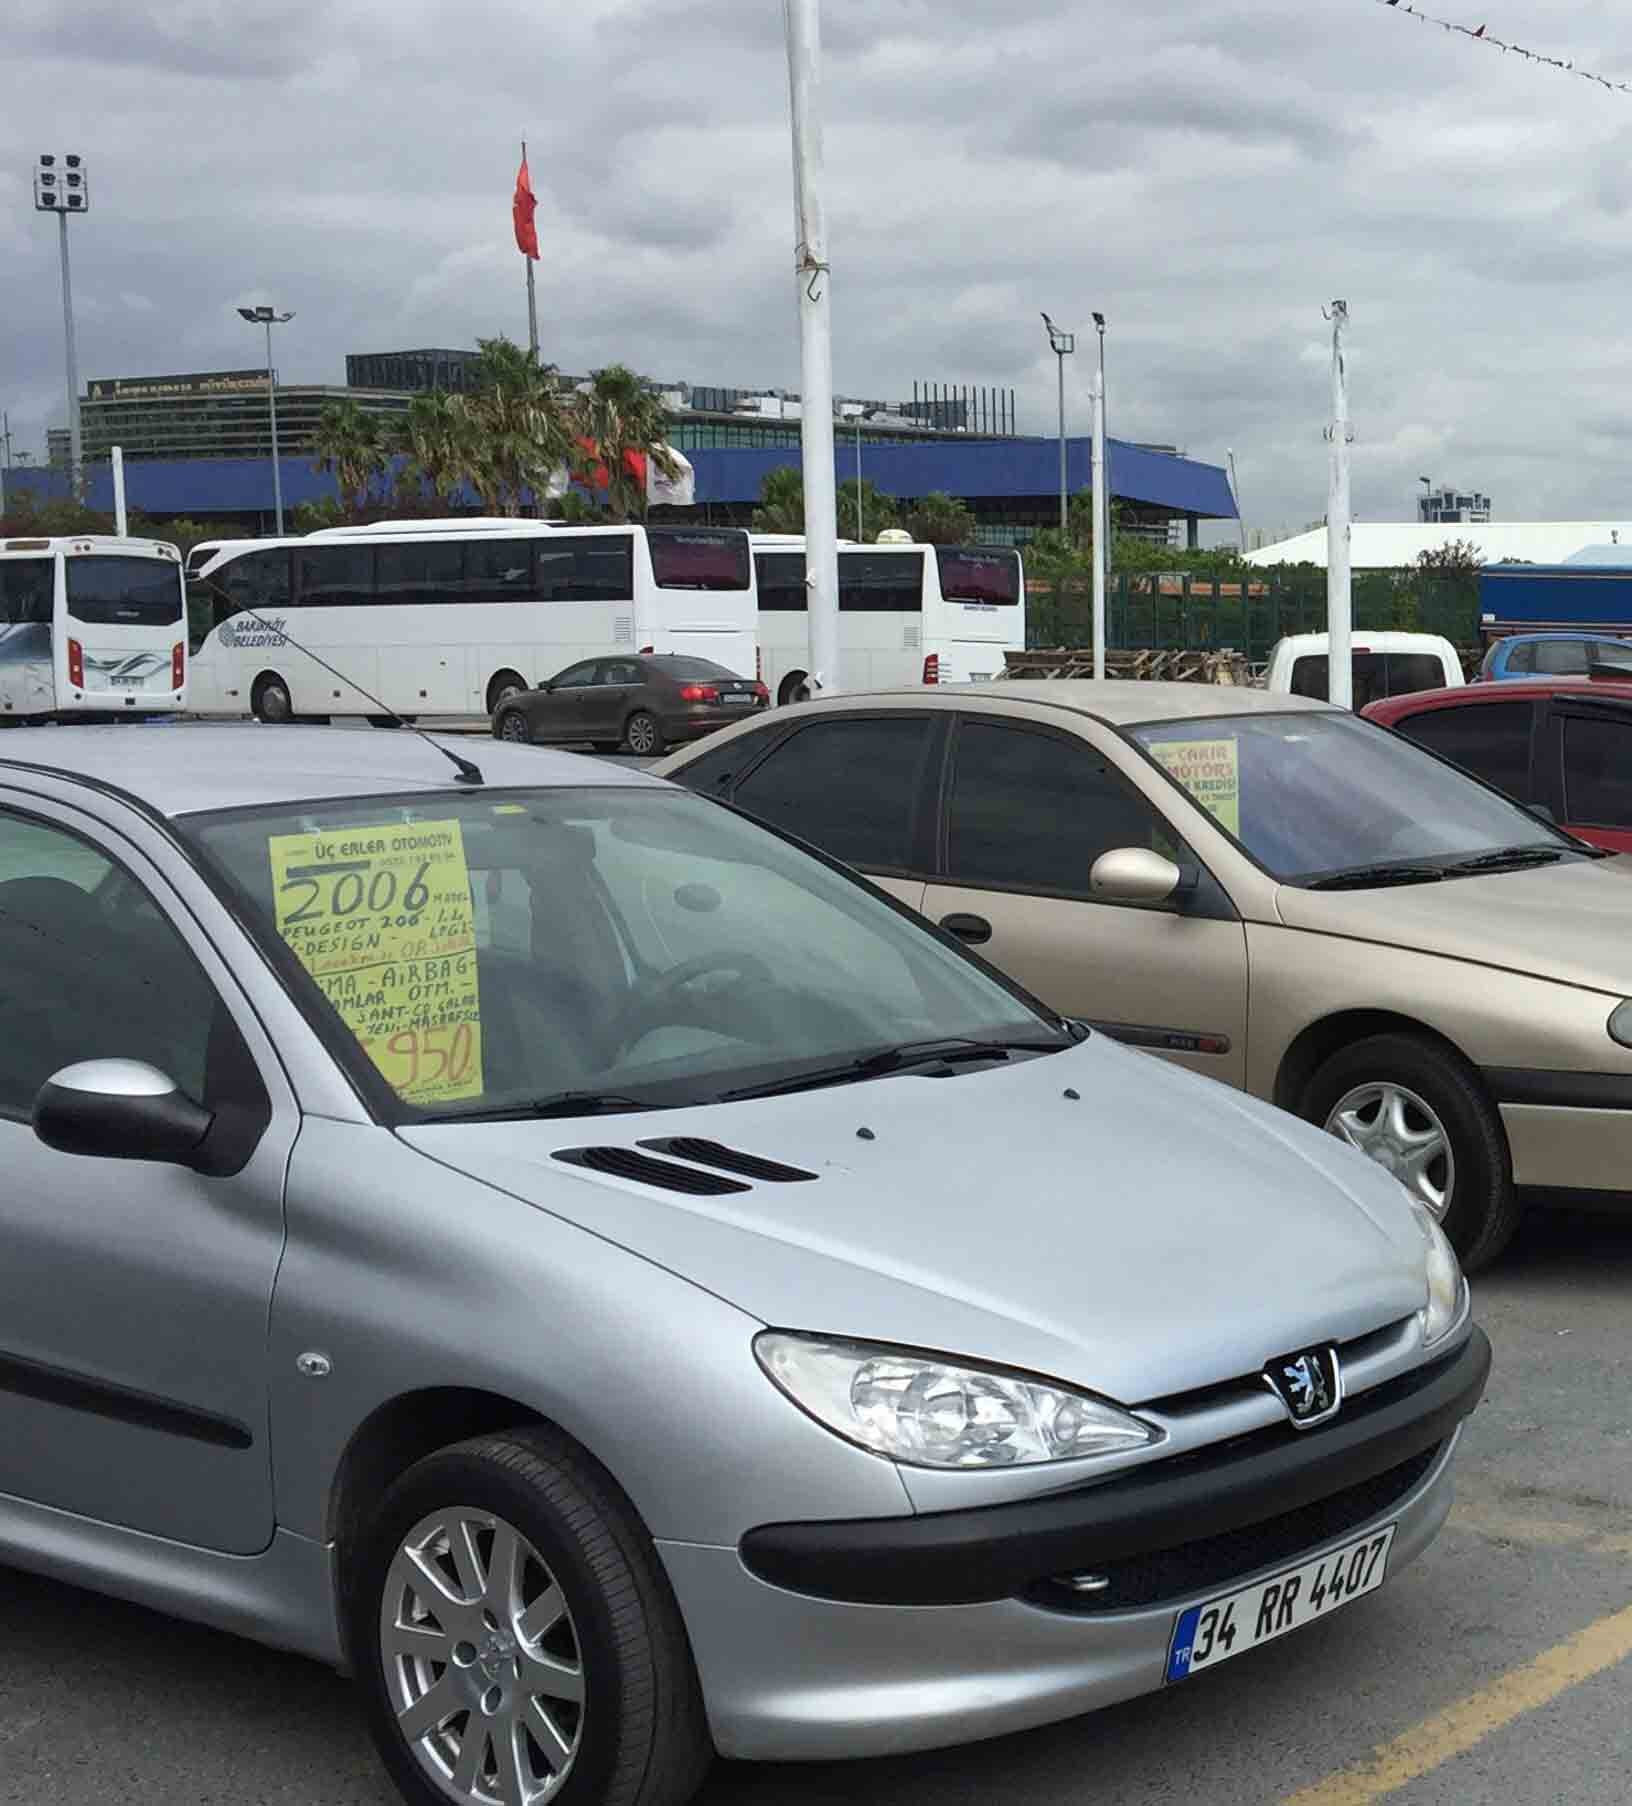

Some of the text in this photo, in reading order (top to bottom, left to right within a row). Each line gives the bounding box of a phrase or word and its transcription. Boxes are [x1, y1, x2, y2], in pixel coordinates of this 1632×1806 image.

[315, 844, 335, 859] ÜÇ
[340, 839, 385, 857] ERLER
[280, 862, 431, 925] 2006
[283, 916, 371, 937] PEUGEOT
[382, 909, 424, 928] 206
[1174, 1534, 1388, 1665] TR 34 RR 4407
